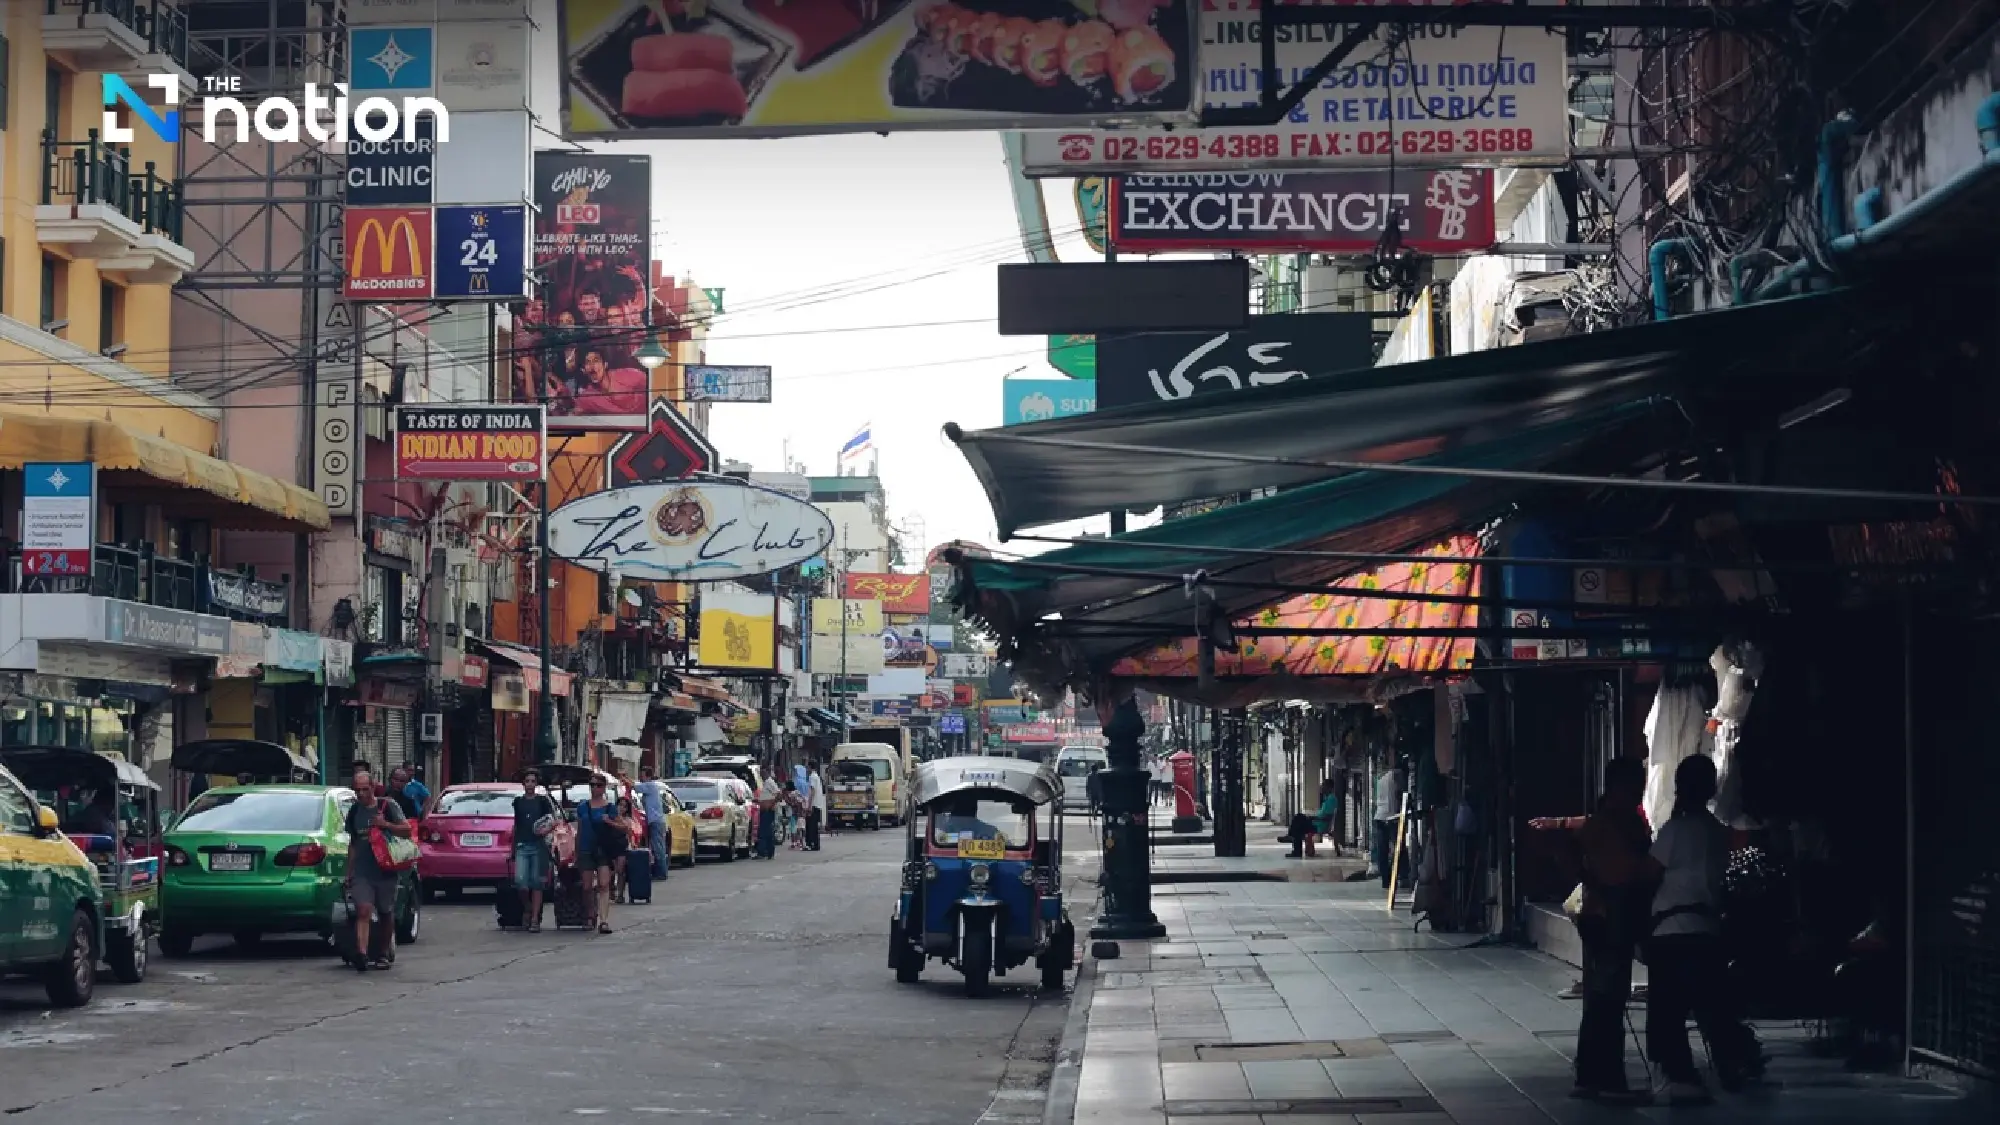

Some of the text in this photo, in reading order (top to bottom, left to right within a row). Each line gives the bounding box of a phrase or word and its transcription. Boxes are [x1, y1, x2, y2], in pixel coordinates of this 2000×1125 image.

[1276, 23, 1378, 43] SILVE
[348, 138, 432, 155] DOCTOR
[1291, 132, 1352, 157] FAX:
[347, 165, 432, 188] CLINIC
[560, 205, 599, 220] LEO
[1122, 190, 1410, 232] EXCHANGE
[534, 233, 580, 243] LEBRATE
[584, 233, 607, 243] LIKE
[578, 244, 603, 254] WITH
[460, 239, 498, 266] 24
[350, 278, 426, 291] McDonald's
[407, 413, 532, 429] TASTE OF INDIA
[322, 384, 350, 509] FOOD
[402, 434, 538, 460] INDIAN FOOD
[573, 505, 816, 560] The Club
[38, 552, 70, 574] 24
